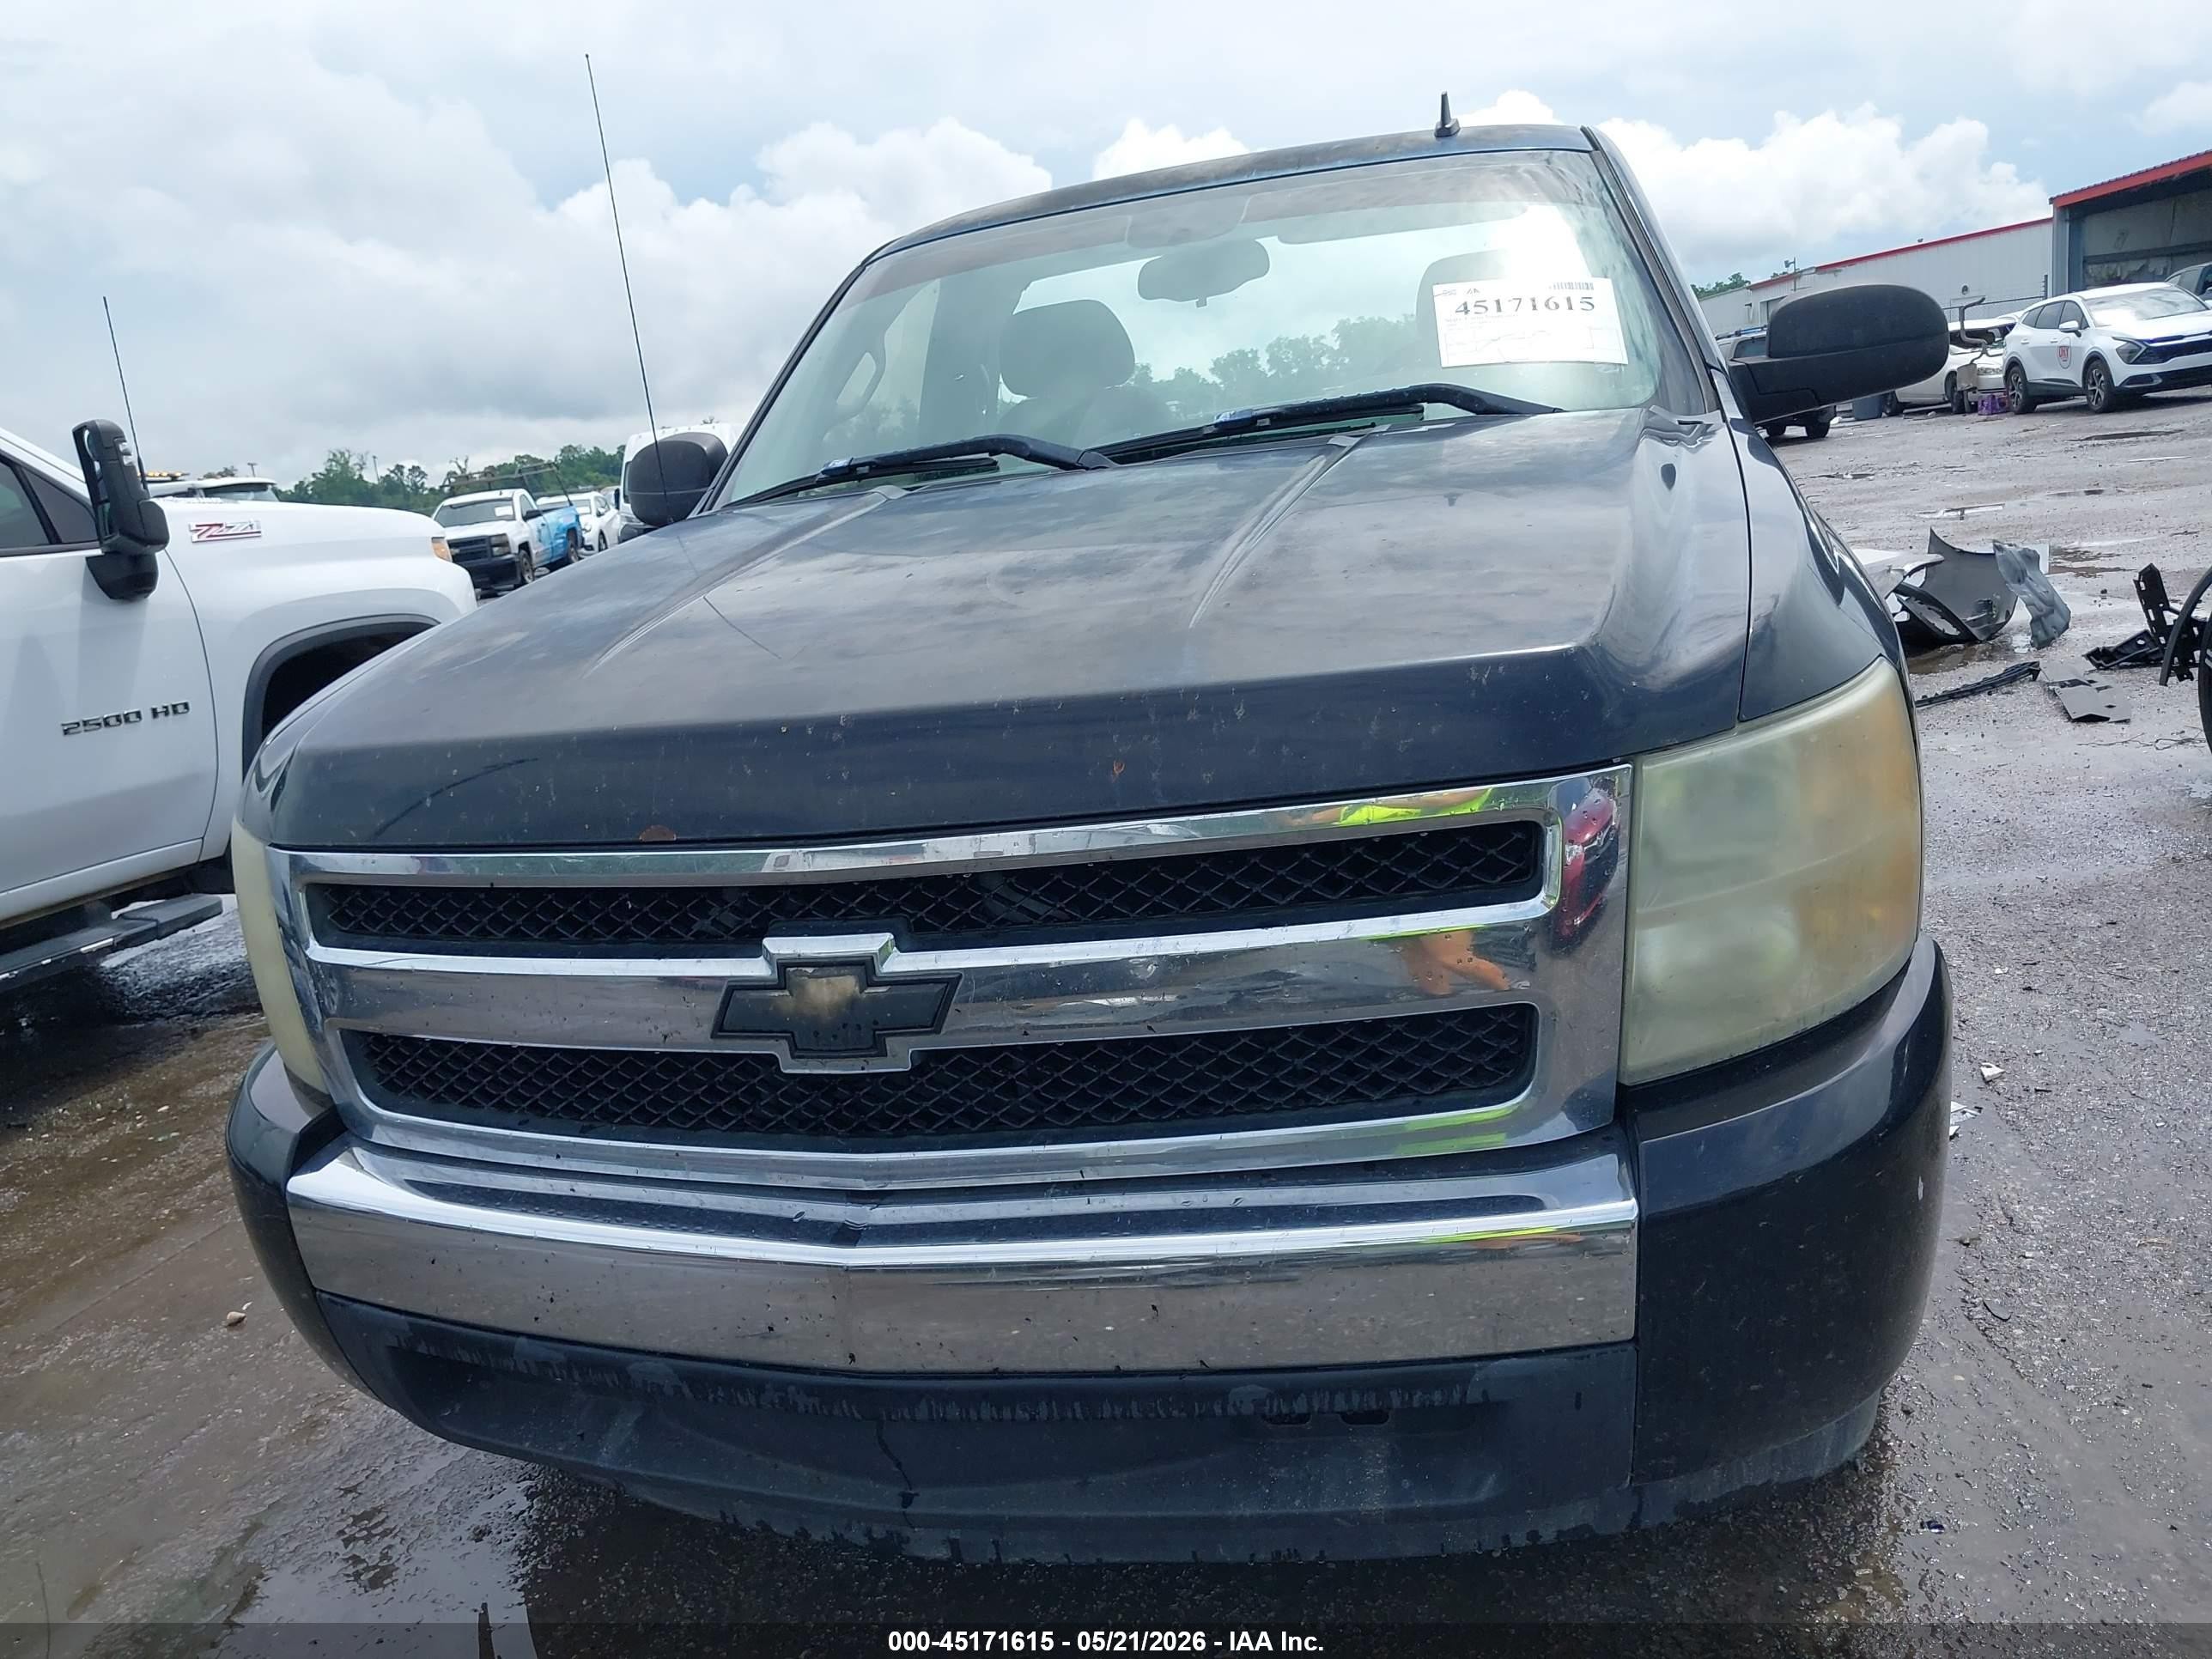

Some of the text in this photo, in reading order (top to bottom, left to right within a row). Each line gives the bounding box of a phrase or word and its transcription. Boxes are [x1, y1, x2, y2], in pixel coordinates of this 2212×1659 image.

[1454, 295, 1595, 316] 45171615
[60, 701, 191, 736] 2500 HD
